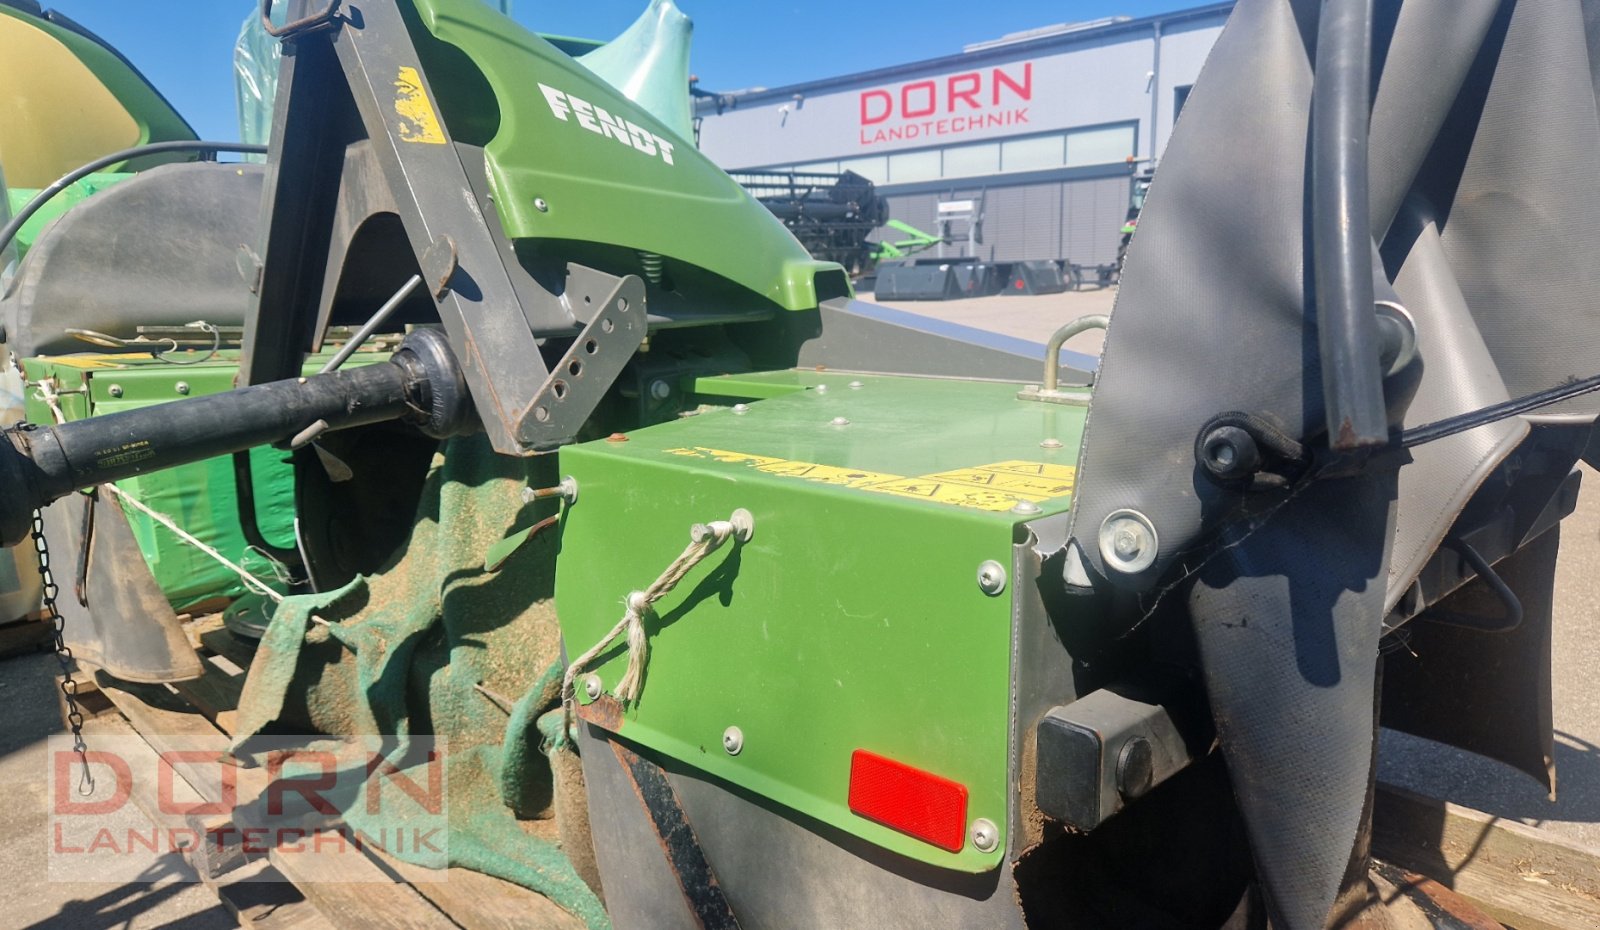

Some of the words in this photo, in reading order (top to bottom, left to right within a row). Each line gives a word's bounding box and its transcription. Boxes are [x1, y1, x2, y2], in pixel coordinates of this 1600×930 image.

[537, 82, 675, 166] FENDT
[860, 62, 1032, 126] DORN
[860, 107, 1029, 145] LANDTECHNIK
